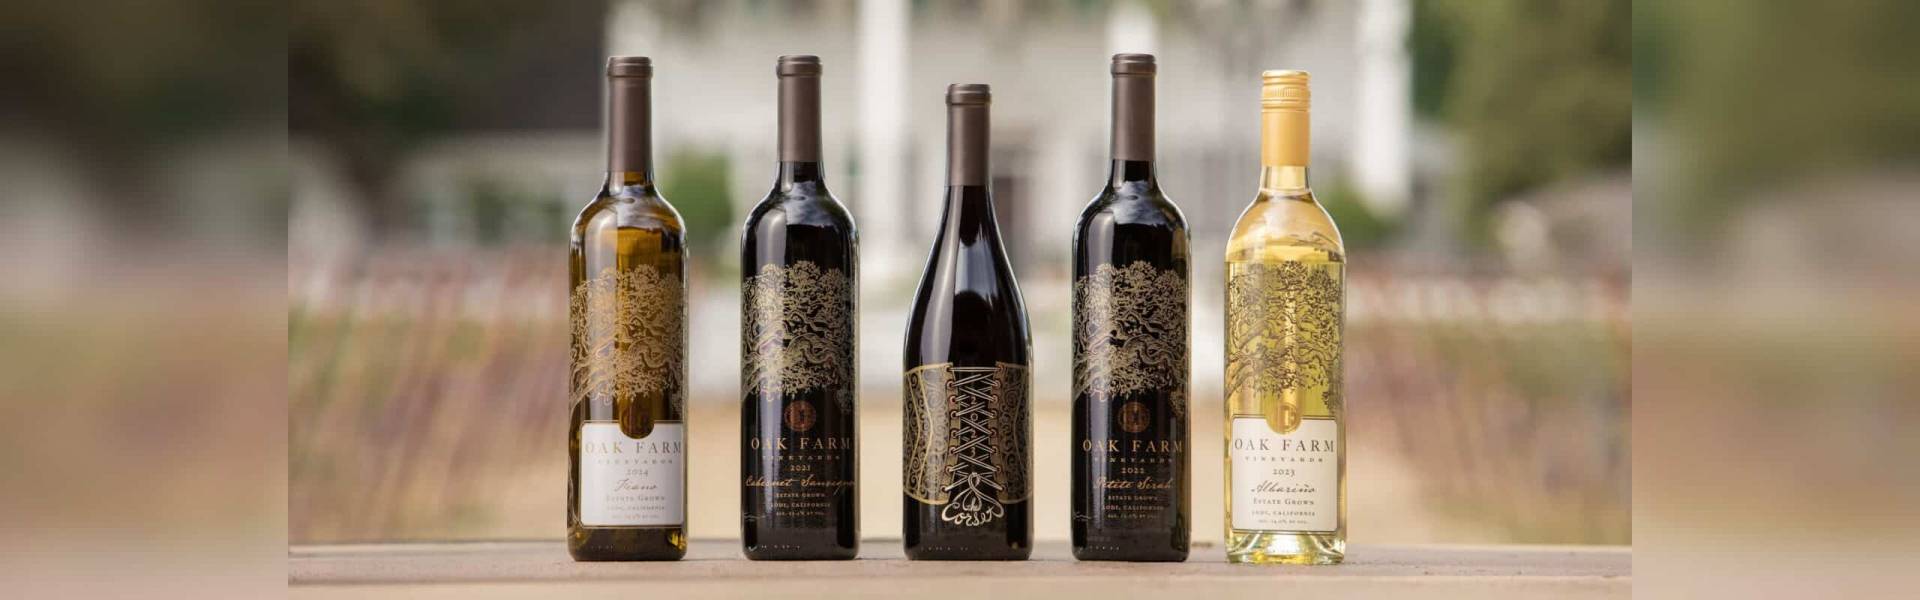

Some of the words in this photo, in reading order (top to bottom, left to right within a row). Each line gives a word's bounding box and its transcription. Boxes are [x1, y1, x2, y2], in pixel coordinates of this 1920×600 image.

[585, 441, 623, 454] OAK
[636, 441, 681, 454] FARM
[751, 437, 788, 450] OAK
[800, 437, 850, 450] FARM
[1082, 439, 1120, 452] OAK
[1132, 439, 1182, 452] FARM
[1234, 438, 1270, 451] OAK
[1282, 439, 1334, 452] FARM
[1272, 469, 1296, 477] 2023
[1094, 476, 1134, 489] Petite
